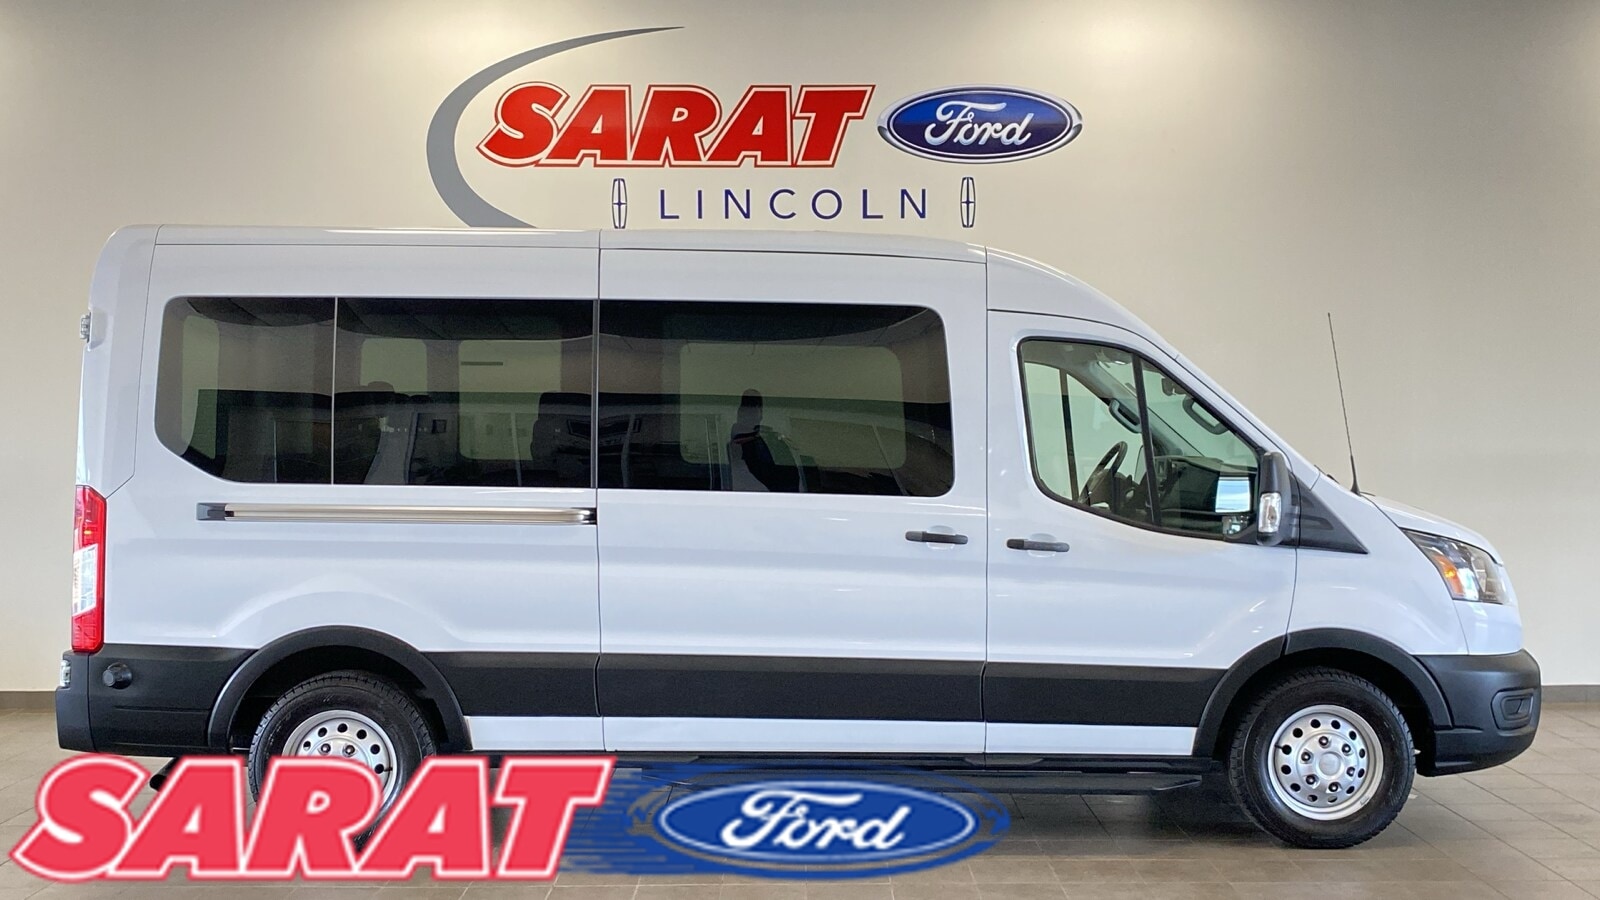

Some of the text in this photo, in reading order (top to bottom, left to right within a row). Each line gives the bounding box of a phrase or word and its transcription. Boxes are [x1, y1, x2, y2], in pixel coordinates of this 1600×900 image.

[476, 82, 876, 168] SARAT
[924, 101, 1031, 147] Ford
[659, 188, 927, 219] LINCOLN
